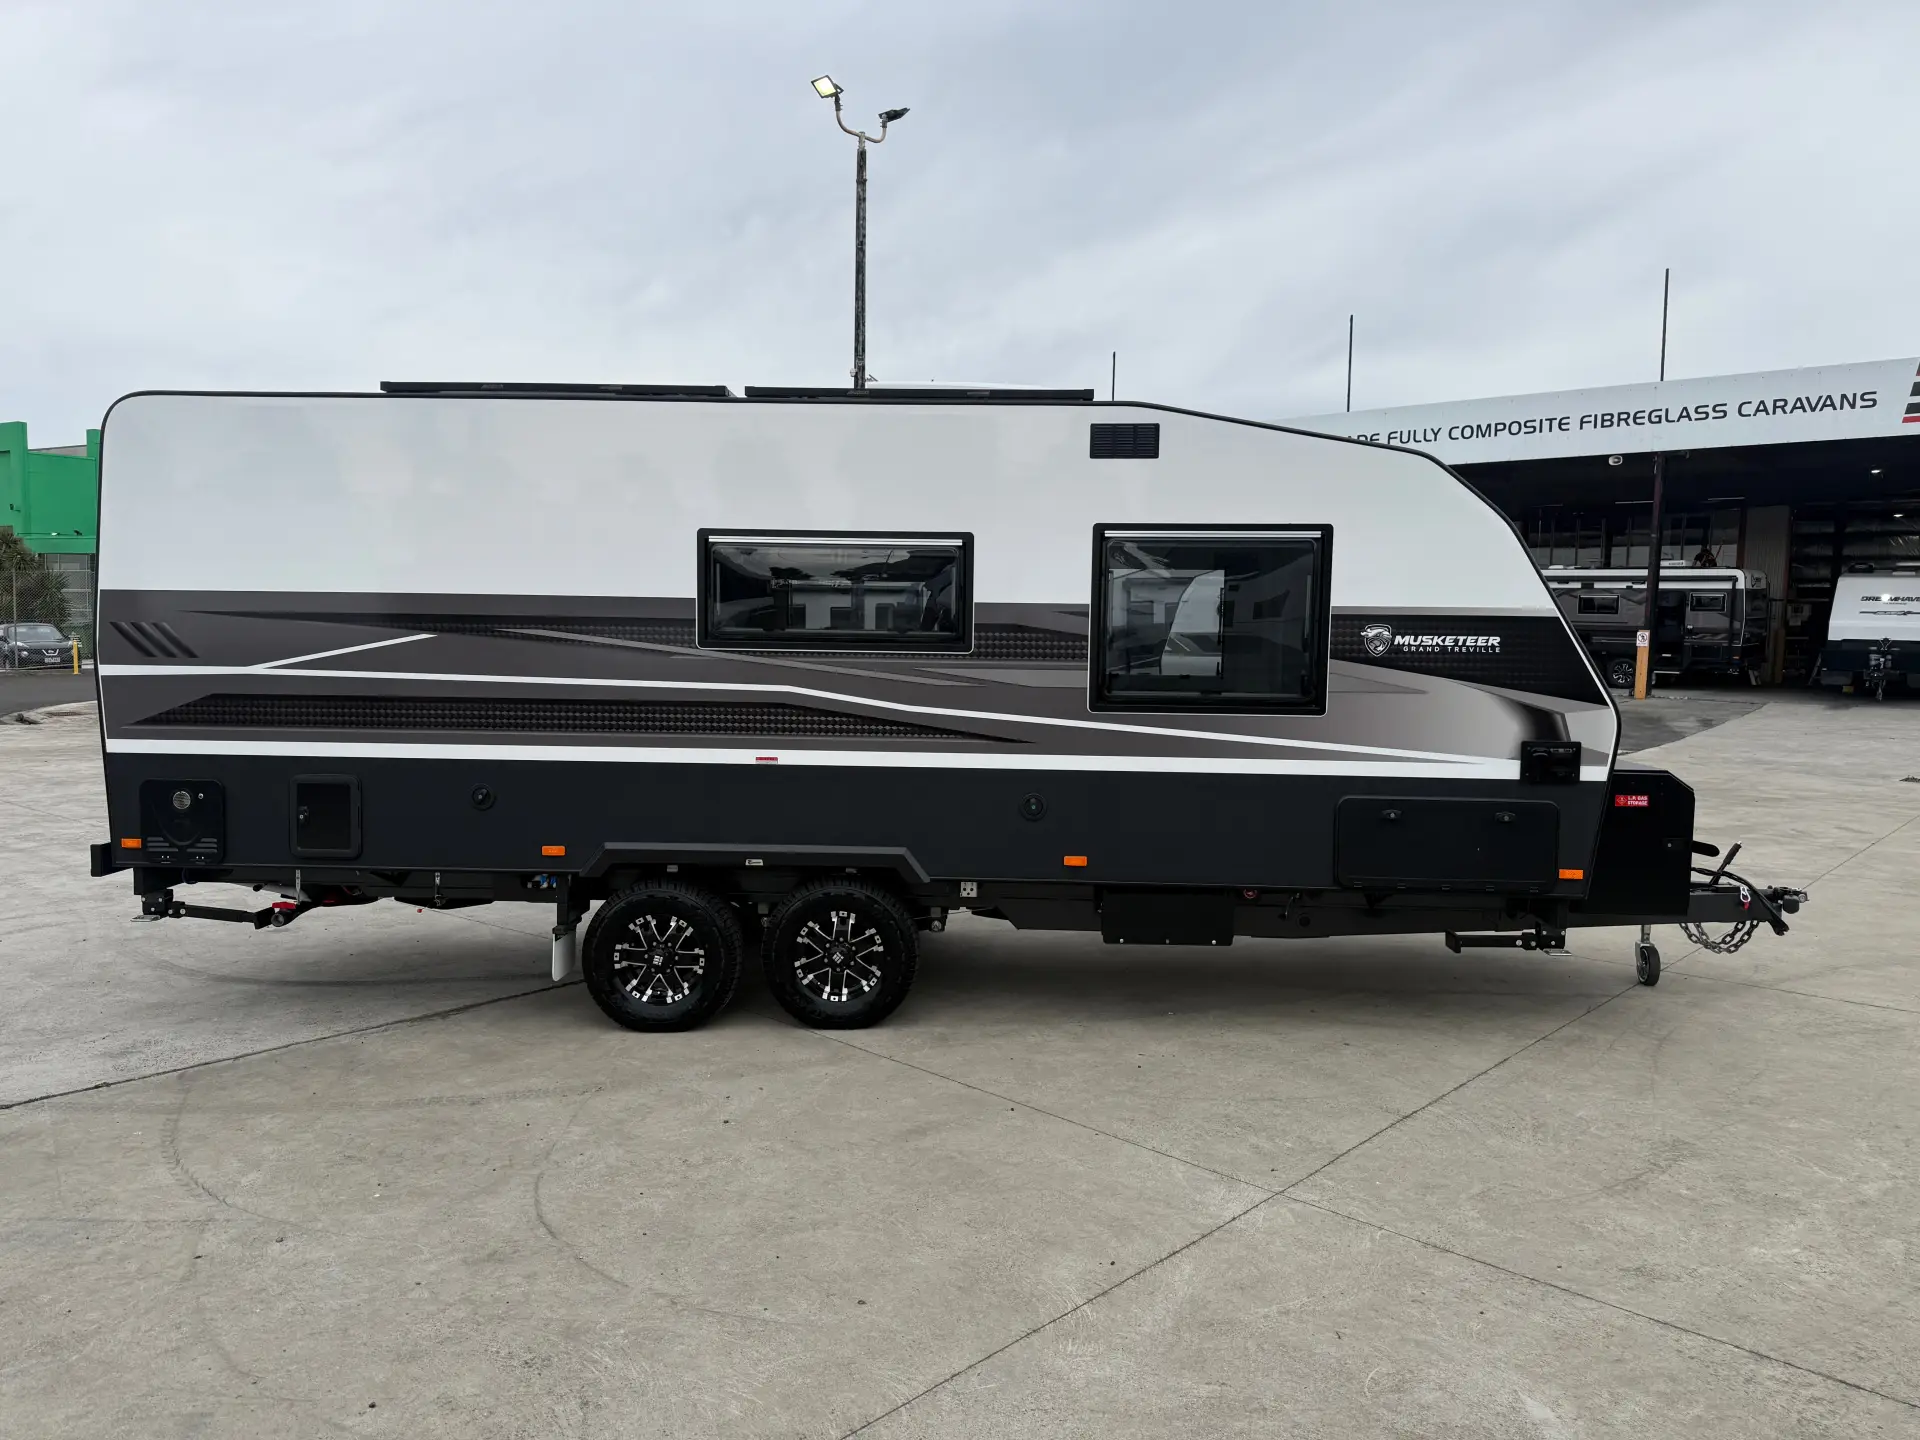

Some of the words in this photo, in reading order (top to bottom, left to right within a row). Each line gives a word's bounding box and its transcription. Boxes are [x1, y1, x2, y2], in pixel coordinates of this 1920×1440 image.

[1387, 427, 1442, 445] FULLY
[1448, 416, 1571, 441] COMPOSITE
[1579, 402, 1728, 431] FIBREGLASS
[1737, 390, 1878, 418] CARAVANS
[1394, 635, 1501, 647] MUSKETEER
